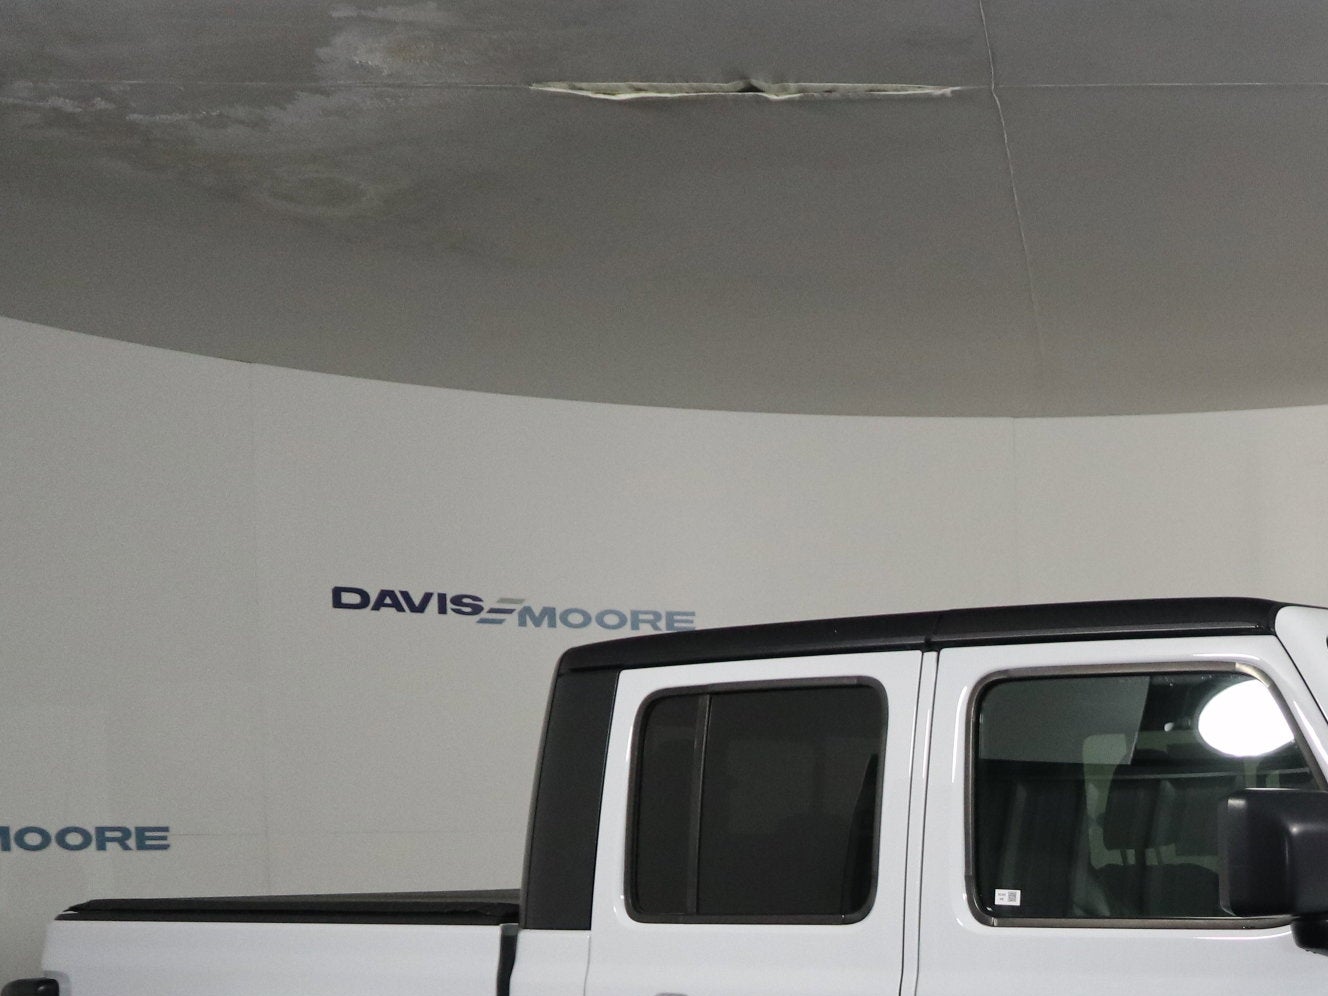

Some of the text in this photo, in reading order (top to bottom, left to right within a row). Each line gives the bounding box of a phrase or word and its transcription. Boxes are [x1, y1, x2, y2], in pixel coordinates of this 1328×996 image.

[331, 586, 697, 632] DAVIS MOORE
[0, 826, 171, 852] OORE
